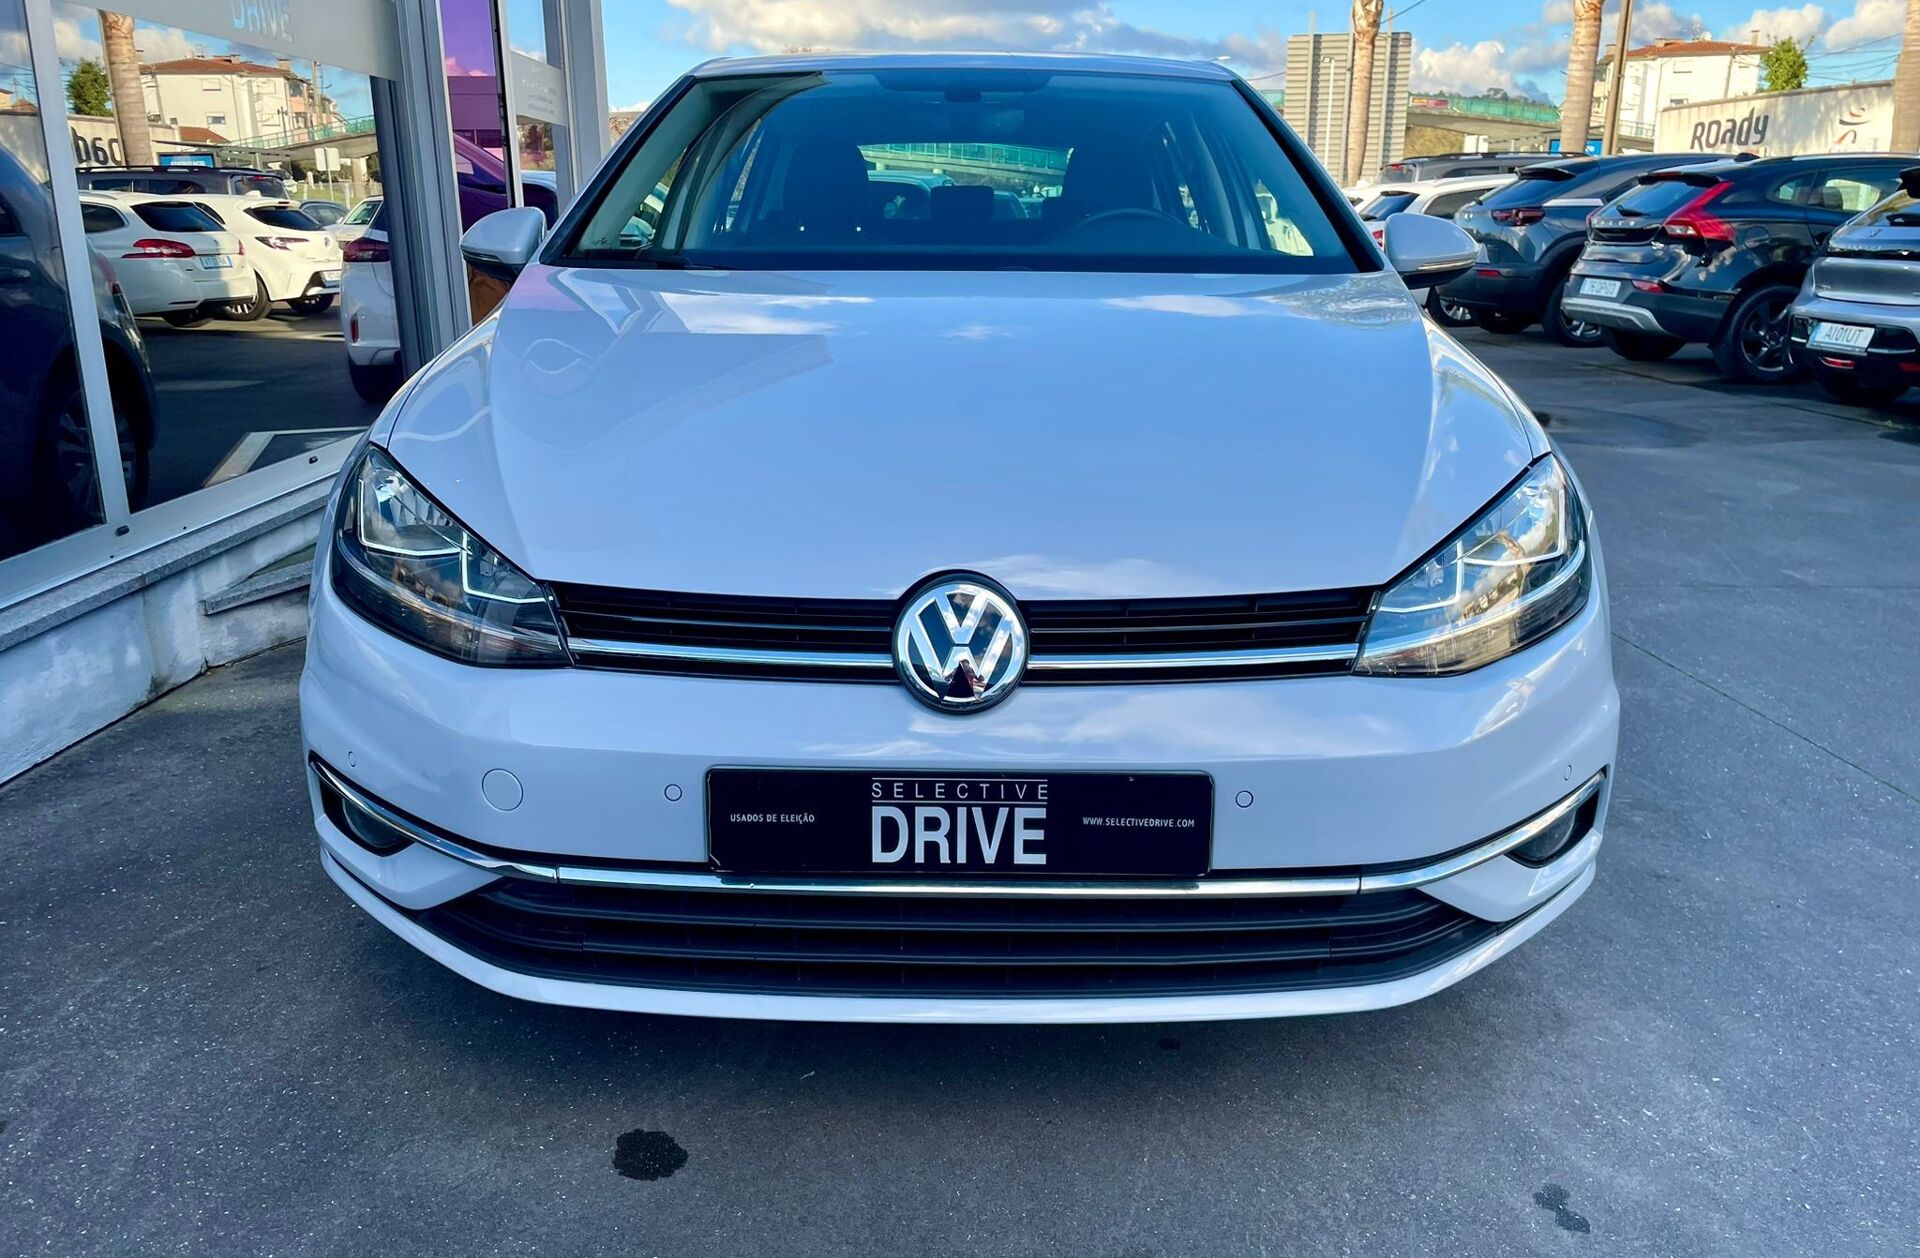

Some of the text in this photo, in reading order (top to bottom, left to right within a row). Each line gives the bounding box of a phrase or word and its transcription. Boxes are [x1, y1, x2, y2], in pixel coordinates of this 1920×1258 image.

[871, 782, 1049, 800] SELECTIVE
[730, 812, 815, 825] USADOS DE ELEIÇÃO
[1082, 816, 1195, 828] WWW.SELECTIVEDRIVE.COM
[871, 805, 1048, 865] DRIVE
